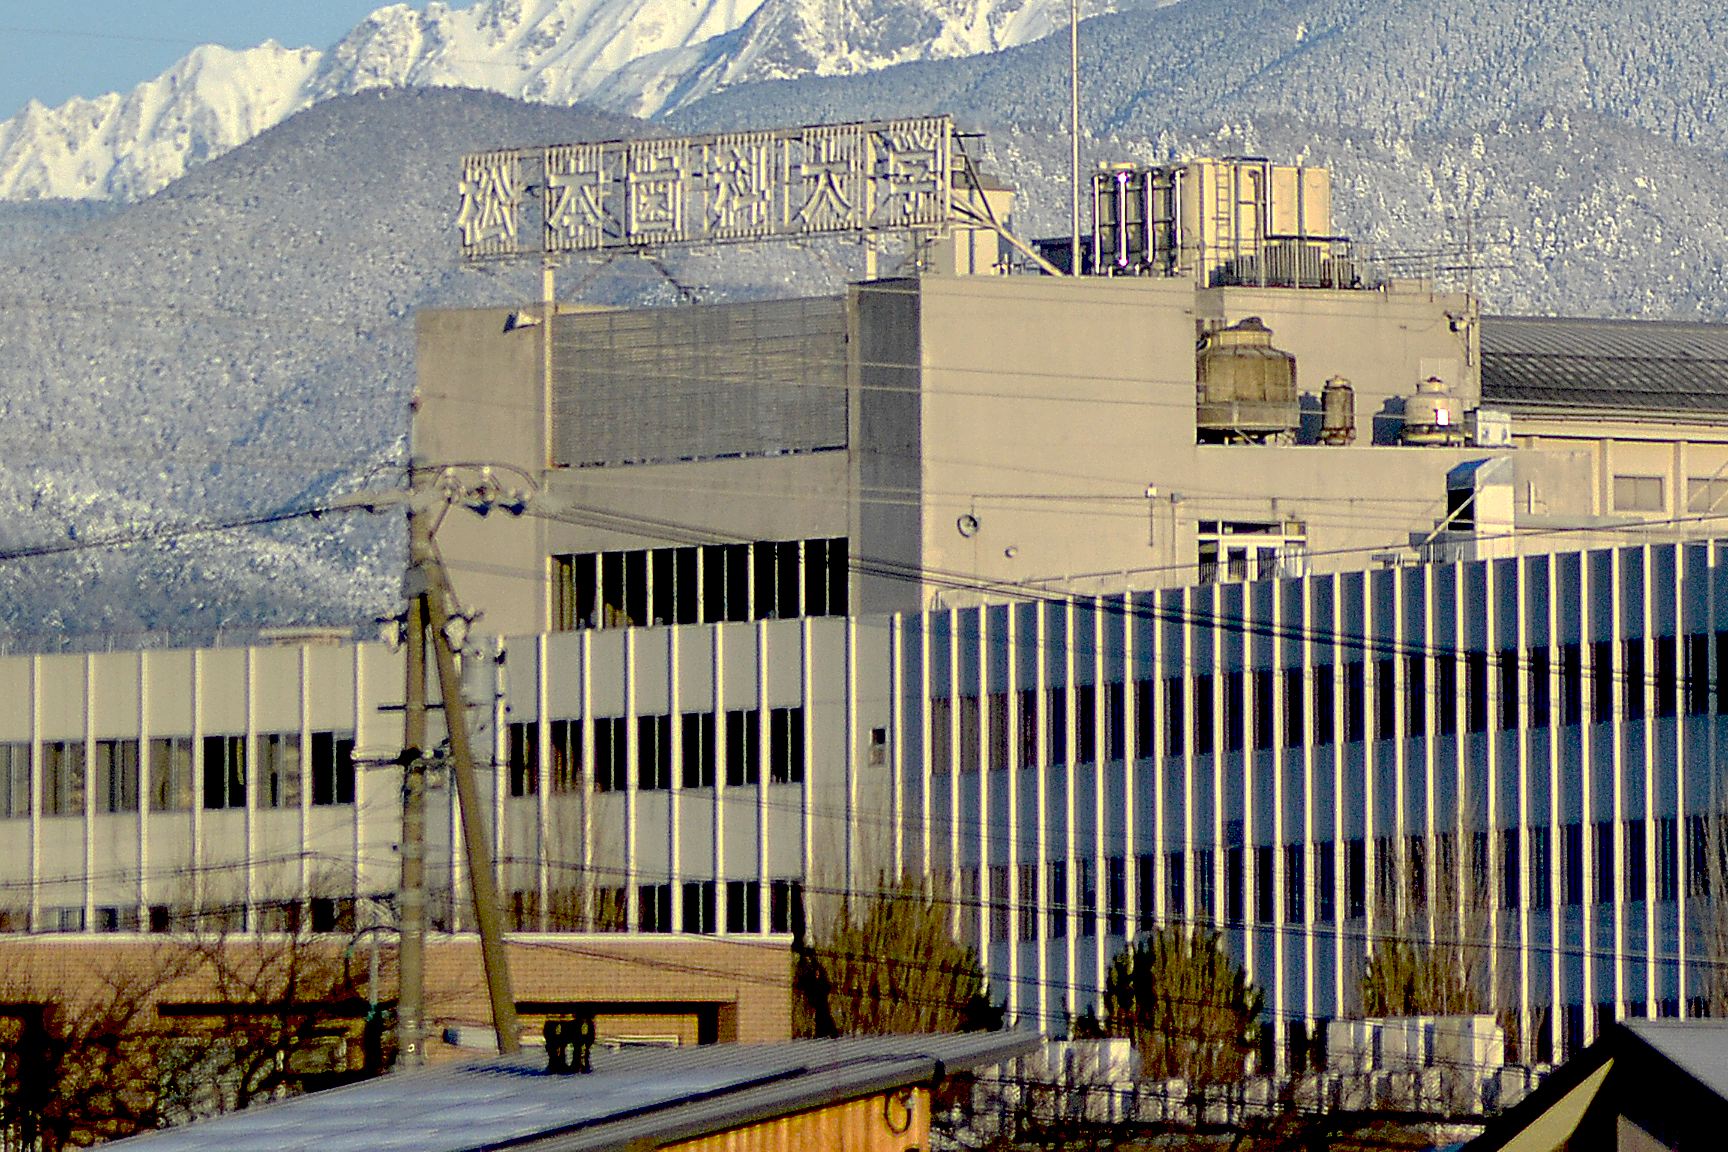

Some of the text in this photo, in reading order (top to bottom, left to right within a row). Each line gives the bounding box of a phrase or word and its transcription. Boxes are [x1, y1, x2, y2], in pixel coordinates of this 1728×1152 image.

[458, 130, 943, 246] 松本歯科大学
